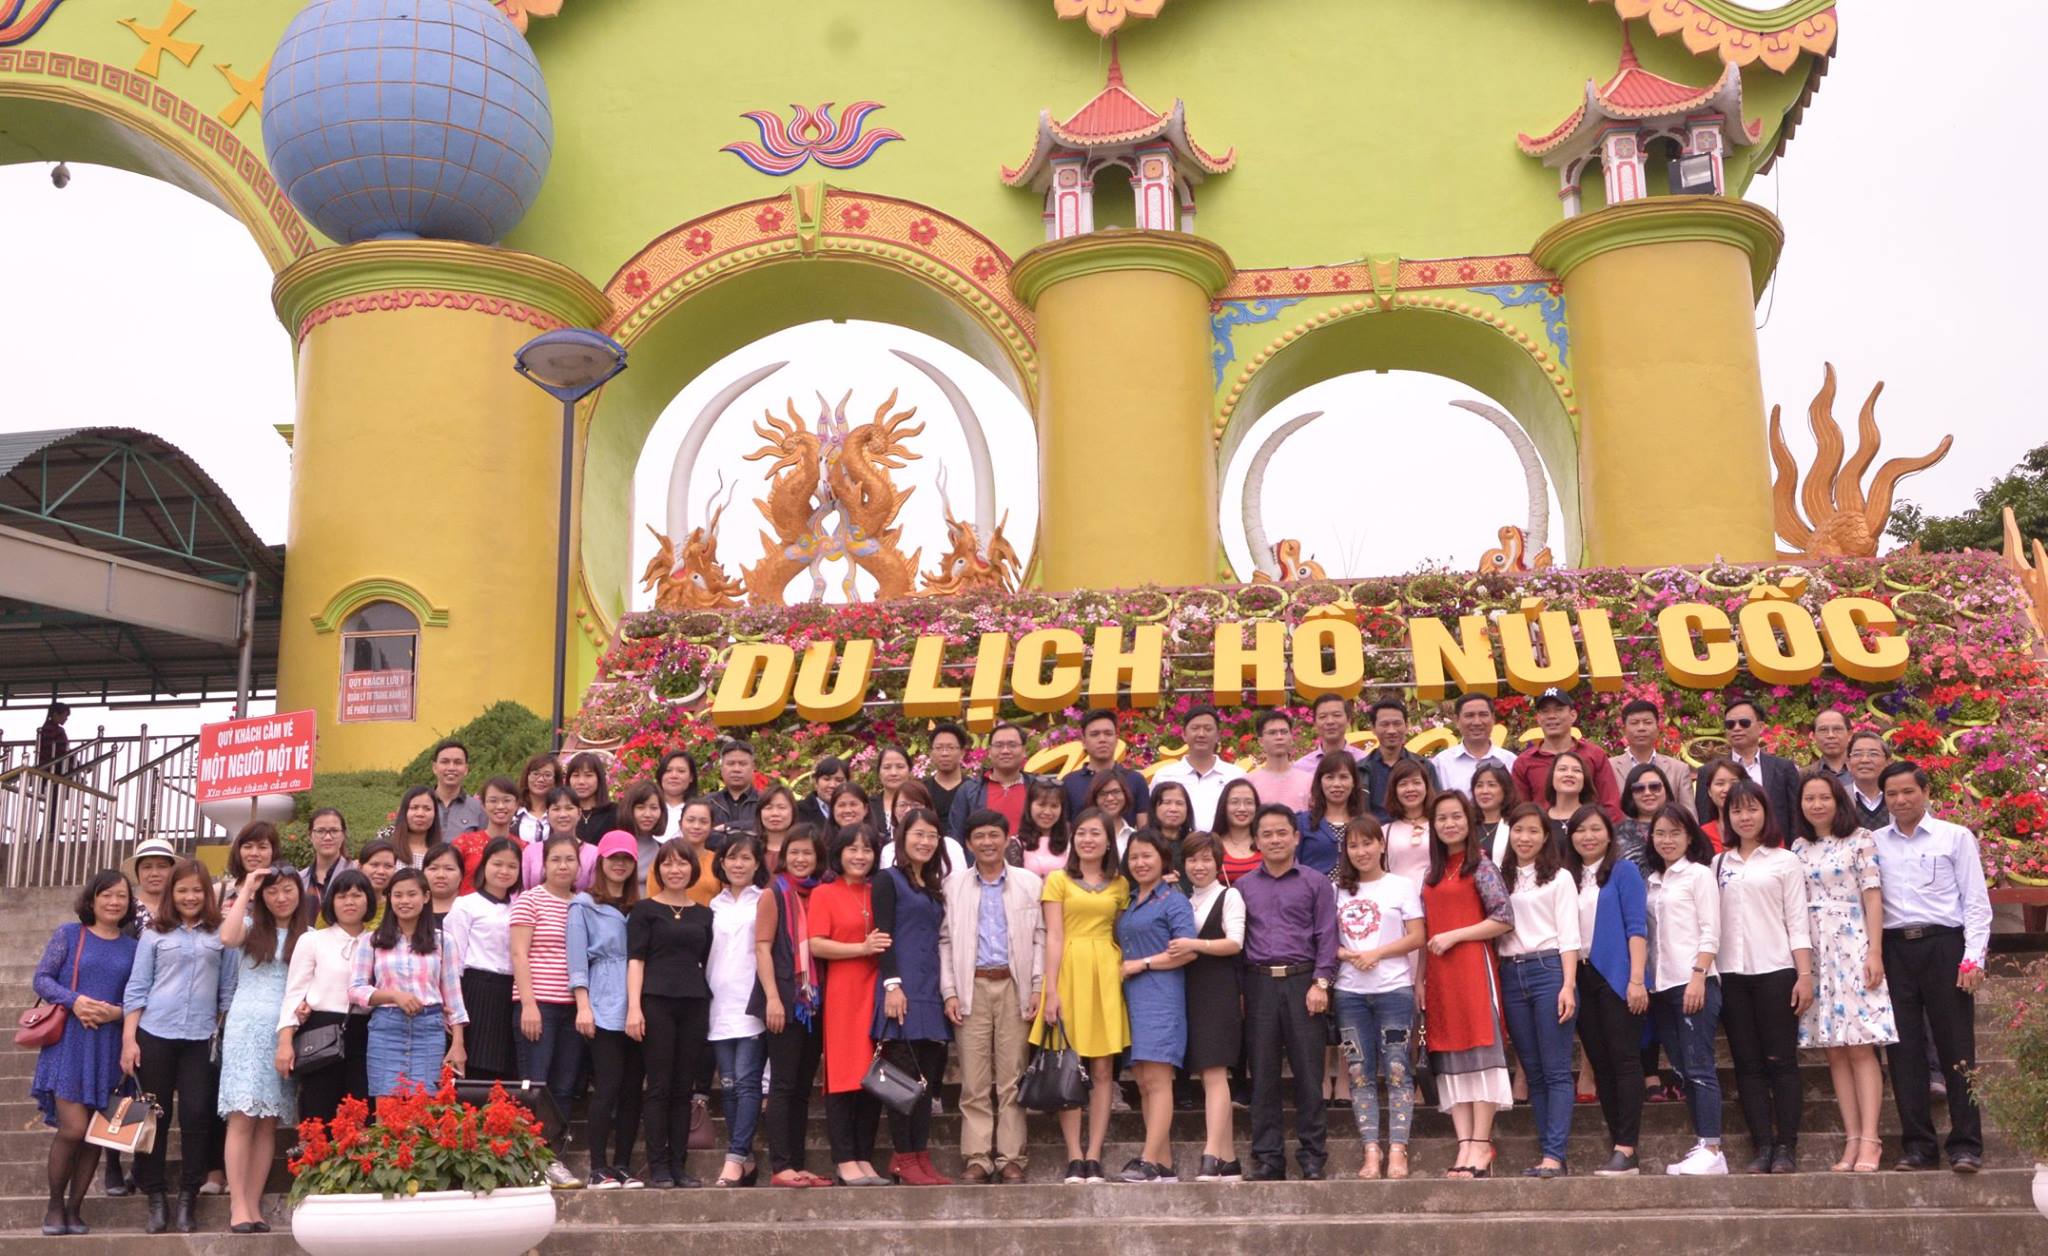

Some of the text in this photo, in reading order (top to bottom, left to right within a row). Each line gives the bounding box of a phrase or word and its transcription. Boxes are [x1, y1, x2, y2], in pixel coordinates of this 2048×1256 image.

[711, 576, 1910, 732] DU LỊCH HỒ NÚI CỐC
[217, 728, 234, 748] QUÝ
[235, 724, 261, 745] KHÁCH
[284, 719, 294, 737] VÉ
[200, 740, 310, 785] MỘT NGƯỜI MỘT VÉ
[205, 788, 221, 798] Xin
